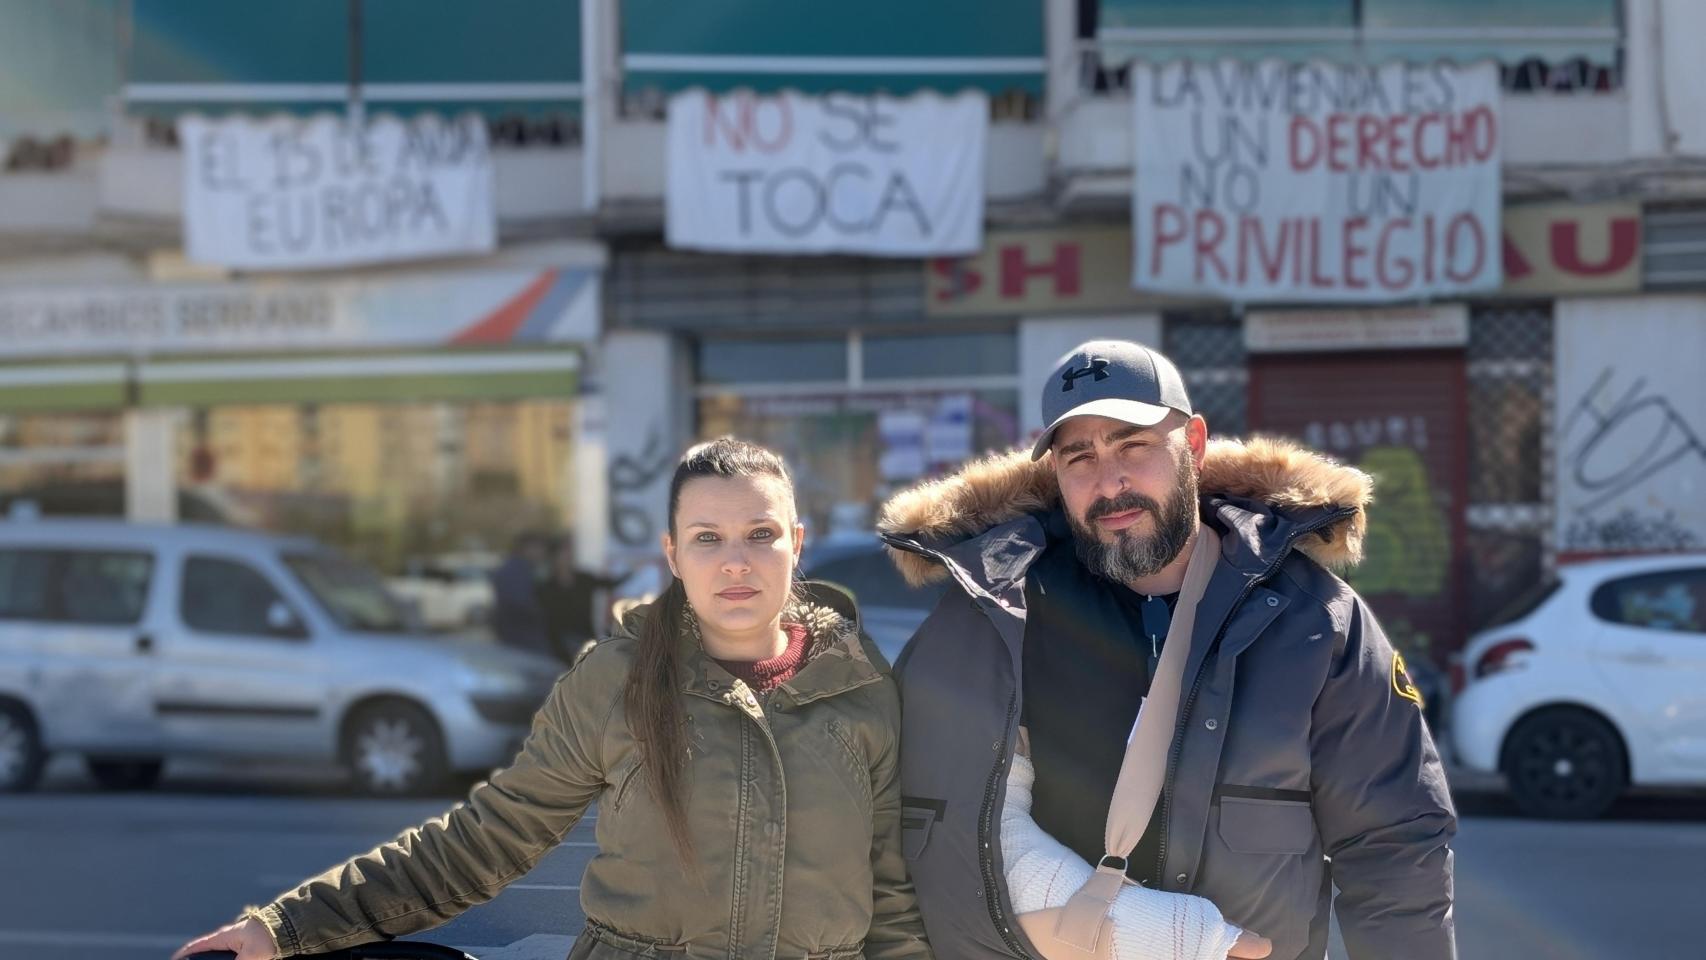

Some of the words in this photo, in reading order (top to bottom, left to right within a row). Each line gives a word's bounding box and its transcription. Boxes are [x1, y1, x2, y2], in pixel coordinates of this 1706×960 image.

[1153, 57, 1203, 107] LA
[1403, 56, 1459, 115] ES
[704, 88, 794, 153] NO
[818, 90, 904, 153] SE
[1192, 110, 1269, 168] UN
[1288, 104, 1496, 173] DERECHO
[201, 128, 255, 192] EL
[270, 124, 324, 191] 15
[1179, 162, 1260, 214] NO
[1346, 170, 1420, 216] UN
[247, 176, 450, 255] EUROPA
[718, 162, 934, 238] TOCA
[1151, 204, 1486, 290] PRIVILEGIO
